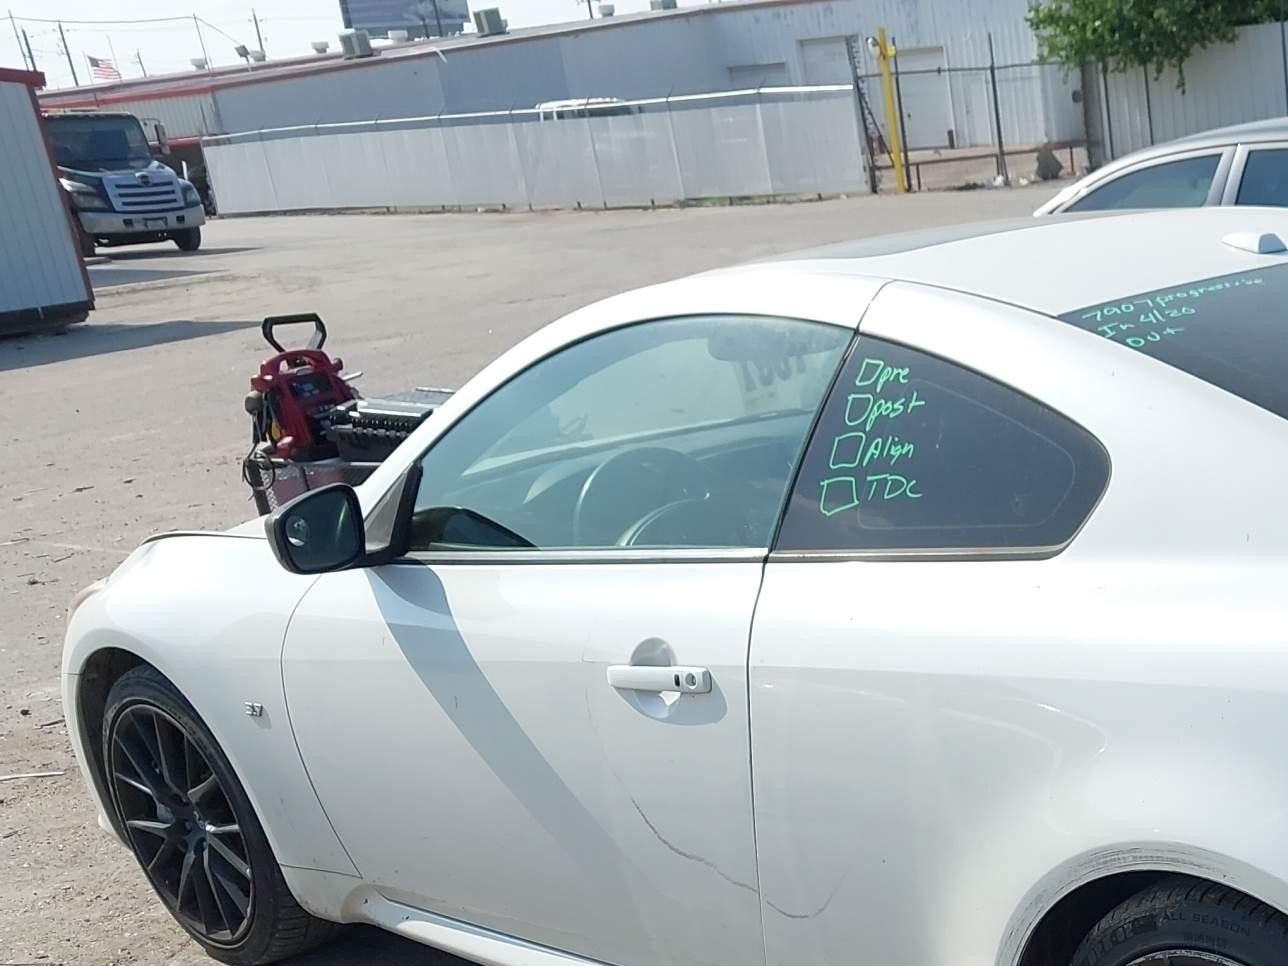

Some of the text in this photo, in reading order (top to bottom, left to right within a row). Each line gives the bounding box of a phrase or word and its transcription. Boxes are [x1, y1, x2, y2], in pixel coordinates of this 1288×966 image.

[876, 362, 910, 392] pre
[866, 391, 925, 430] post
[862, 436, 914, 468] Align
[1192, 912, 1252, 937] SEASON
